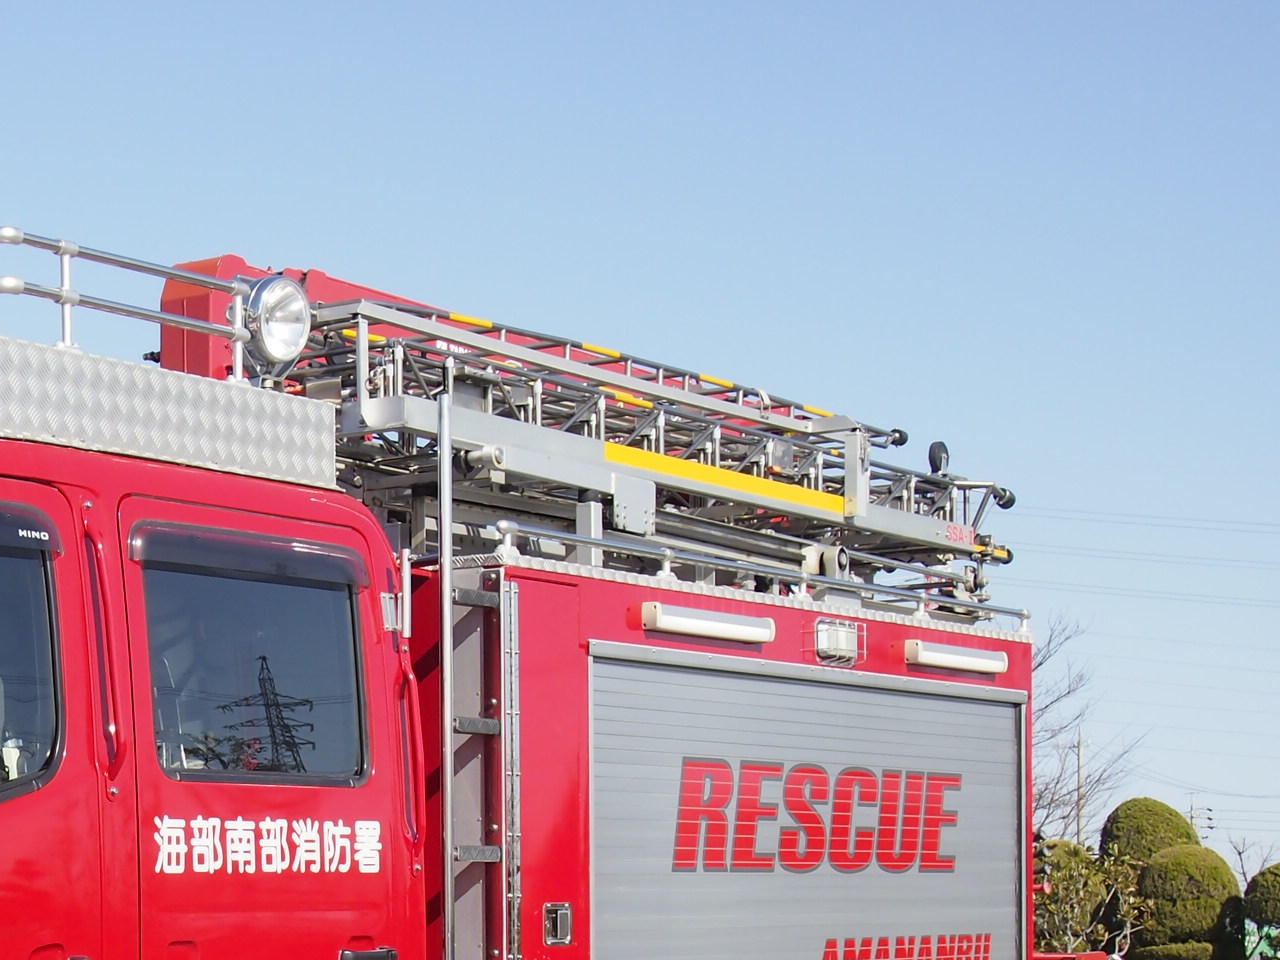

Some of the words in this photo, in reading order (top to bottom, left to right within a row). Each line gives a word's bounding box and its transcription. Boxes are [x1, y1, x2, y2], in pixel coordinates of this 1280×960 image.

[18, 528, 50, 540] HINO
[153, 814, 382, 874] 海部南部消防署
[671, 756, 962, 874] RESCUE
